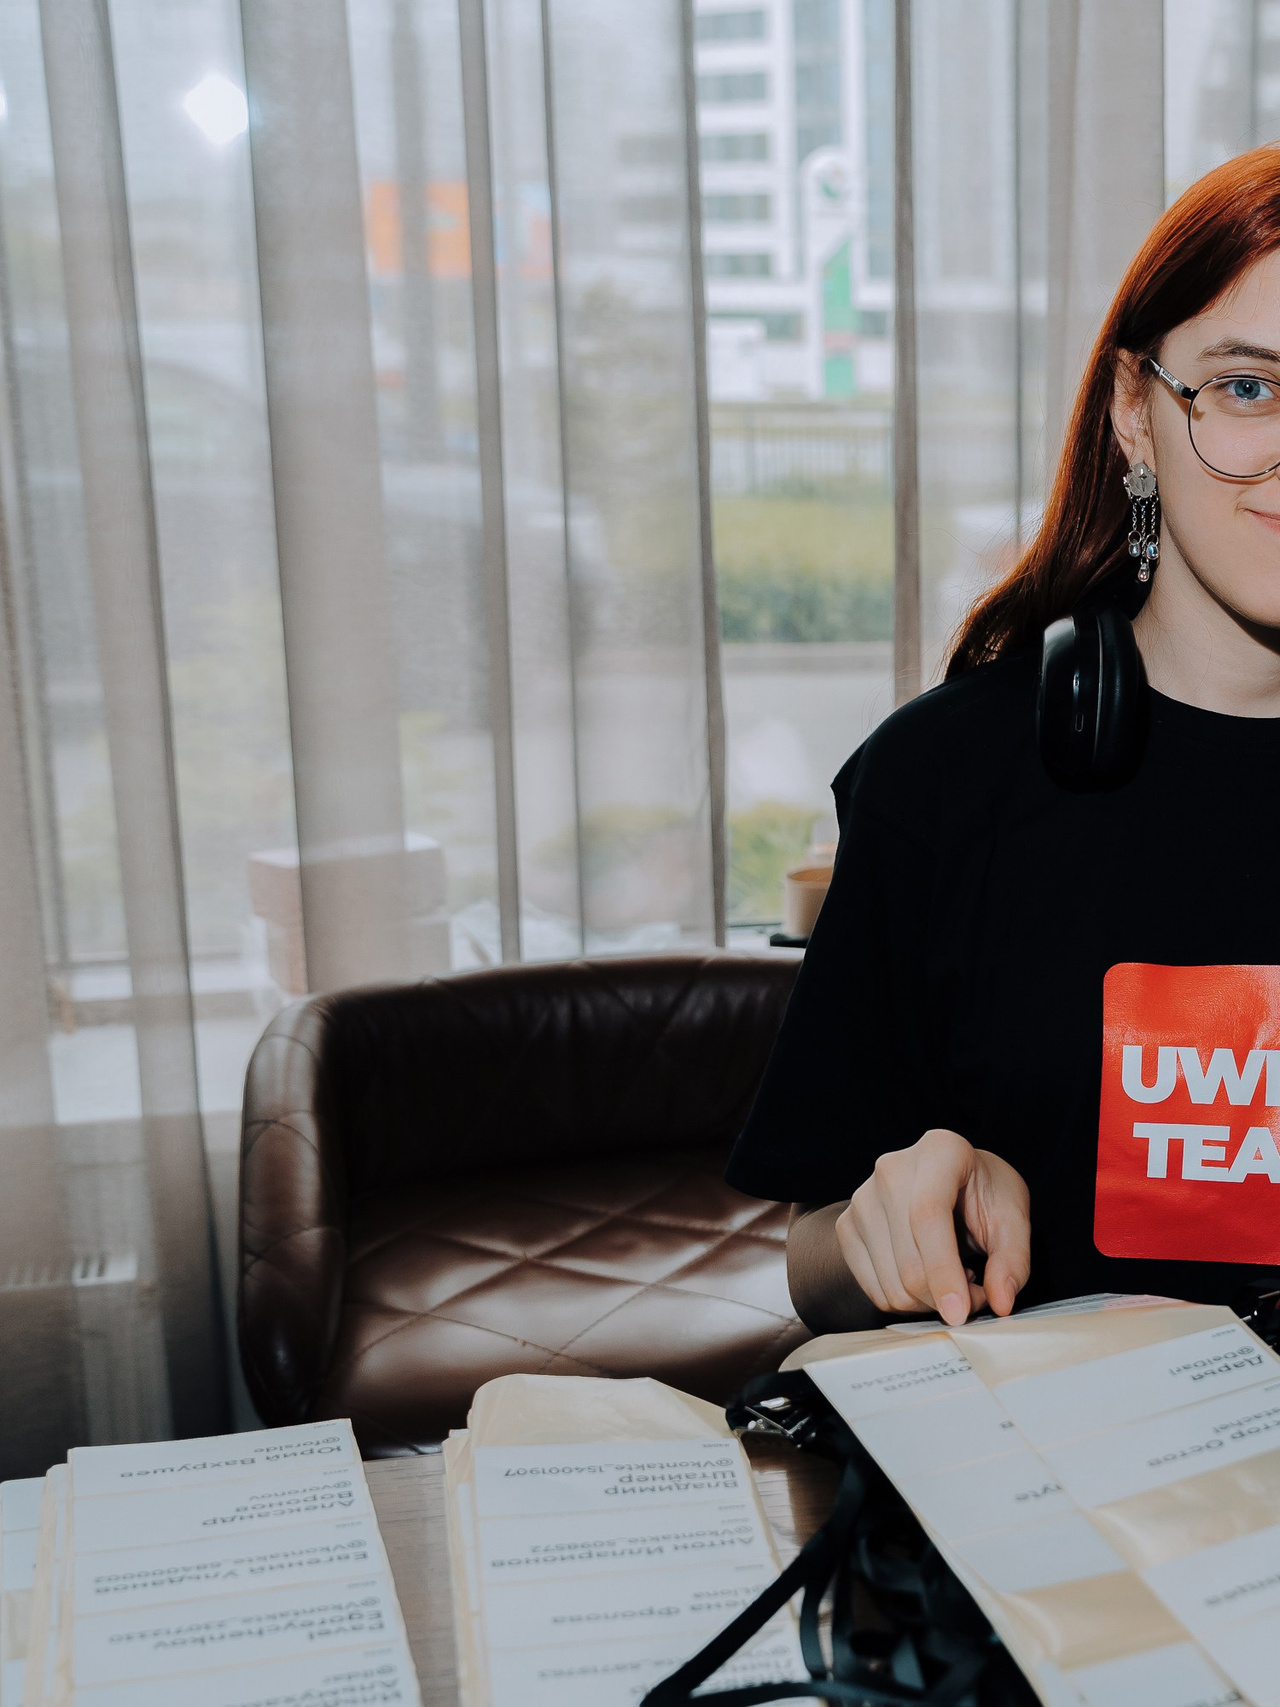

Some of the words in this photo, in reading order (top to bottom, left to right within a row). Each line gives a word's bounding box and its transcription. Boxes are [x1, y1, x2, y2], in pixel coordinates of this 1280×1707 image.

[882, 1365, 974, 1393] ориков
[1189, 1354, 1264, 1383] Дарья
[265, 1445, 342, 1463] Юрий
[119, 1456, 256, 1480] Вахрушев
[618, 1469, 737, 1484] Штайнер
[234, 1489, 354, 1513] Воронов
[248, 1480, 353, 1502] @voronov
[604, 1480, 739, 1498] Владимир
[200, 1498, 356, 1528] Александр
[673, 1536, 755, 1554] Антон
[248, 1550, 370, 1576] Евгений
[490, 1546, 665, 1570] Илларионов
[551, 1605, 681, 1627] Фролова
[306, 1620, 386, 1645] Pavel
